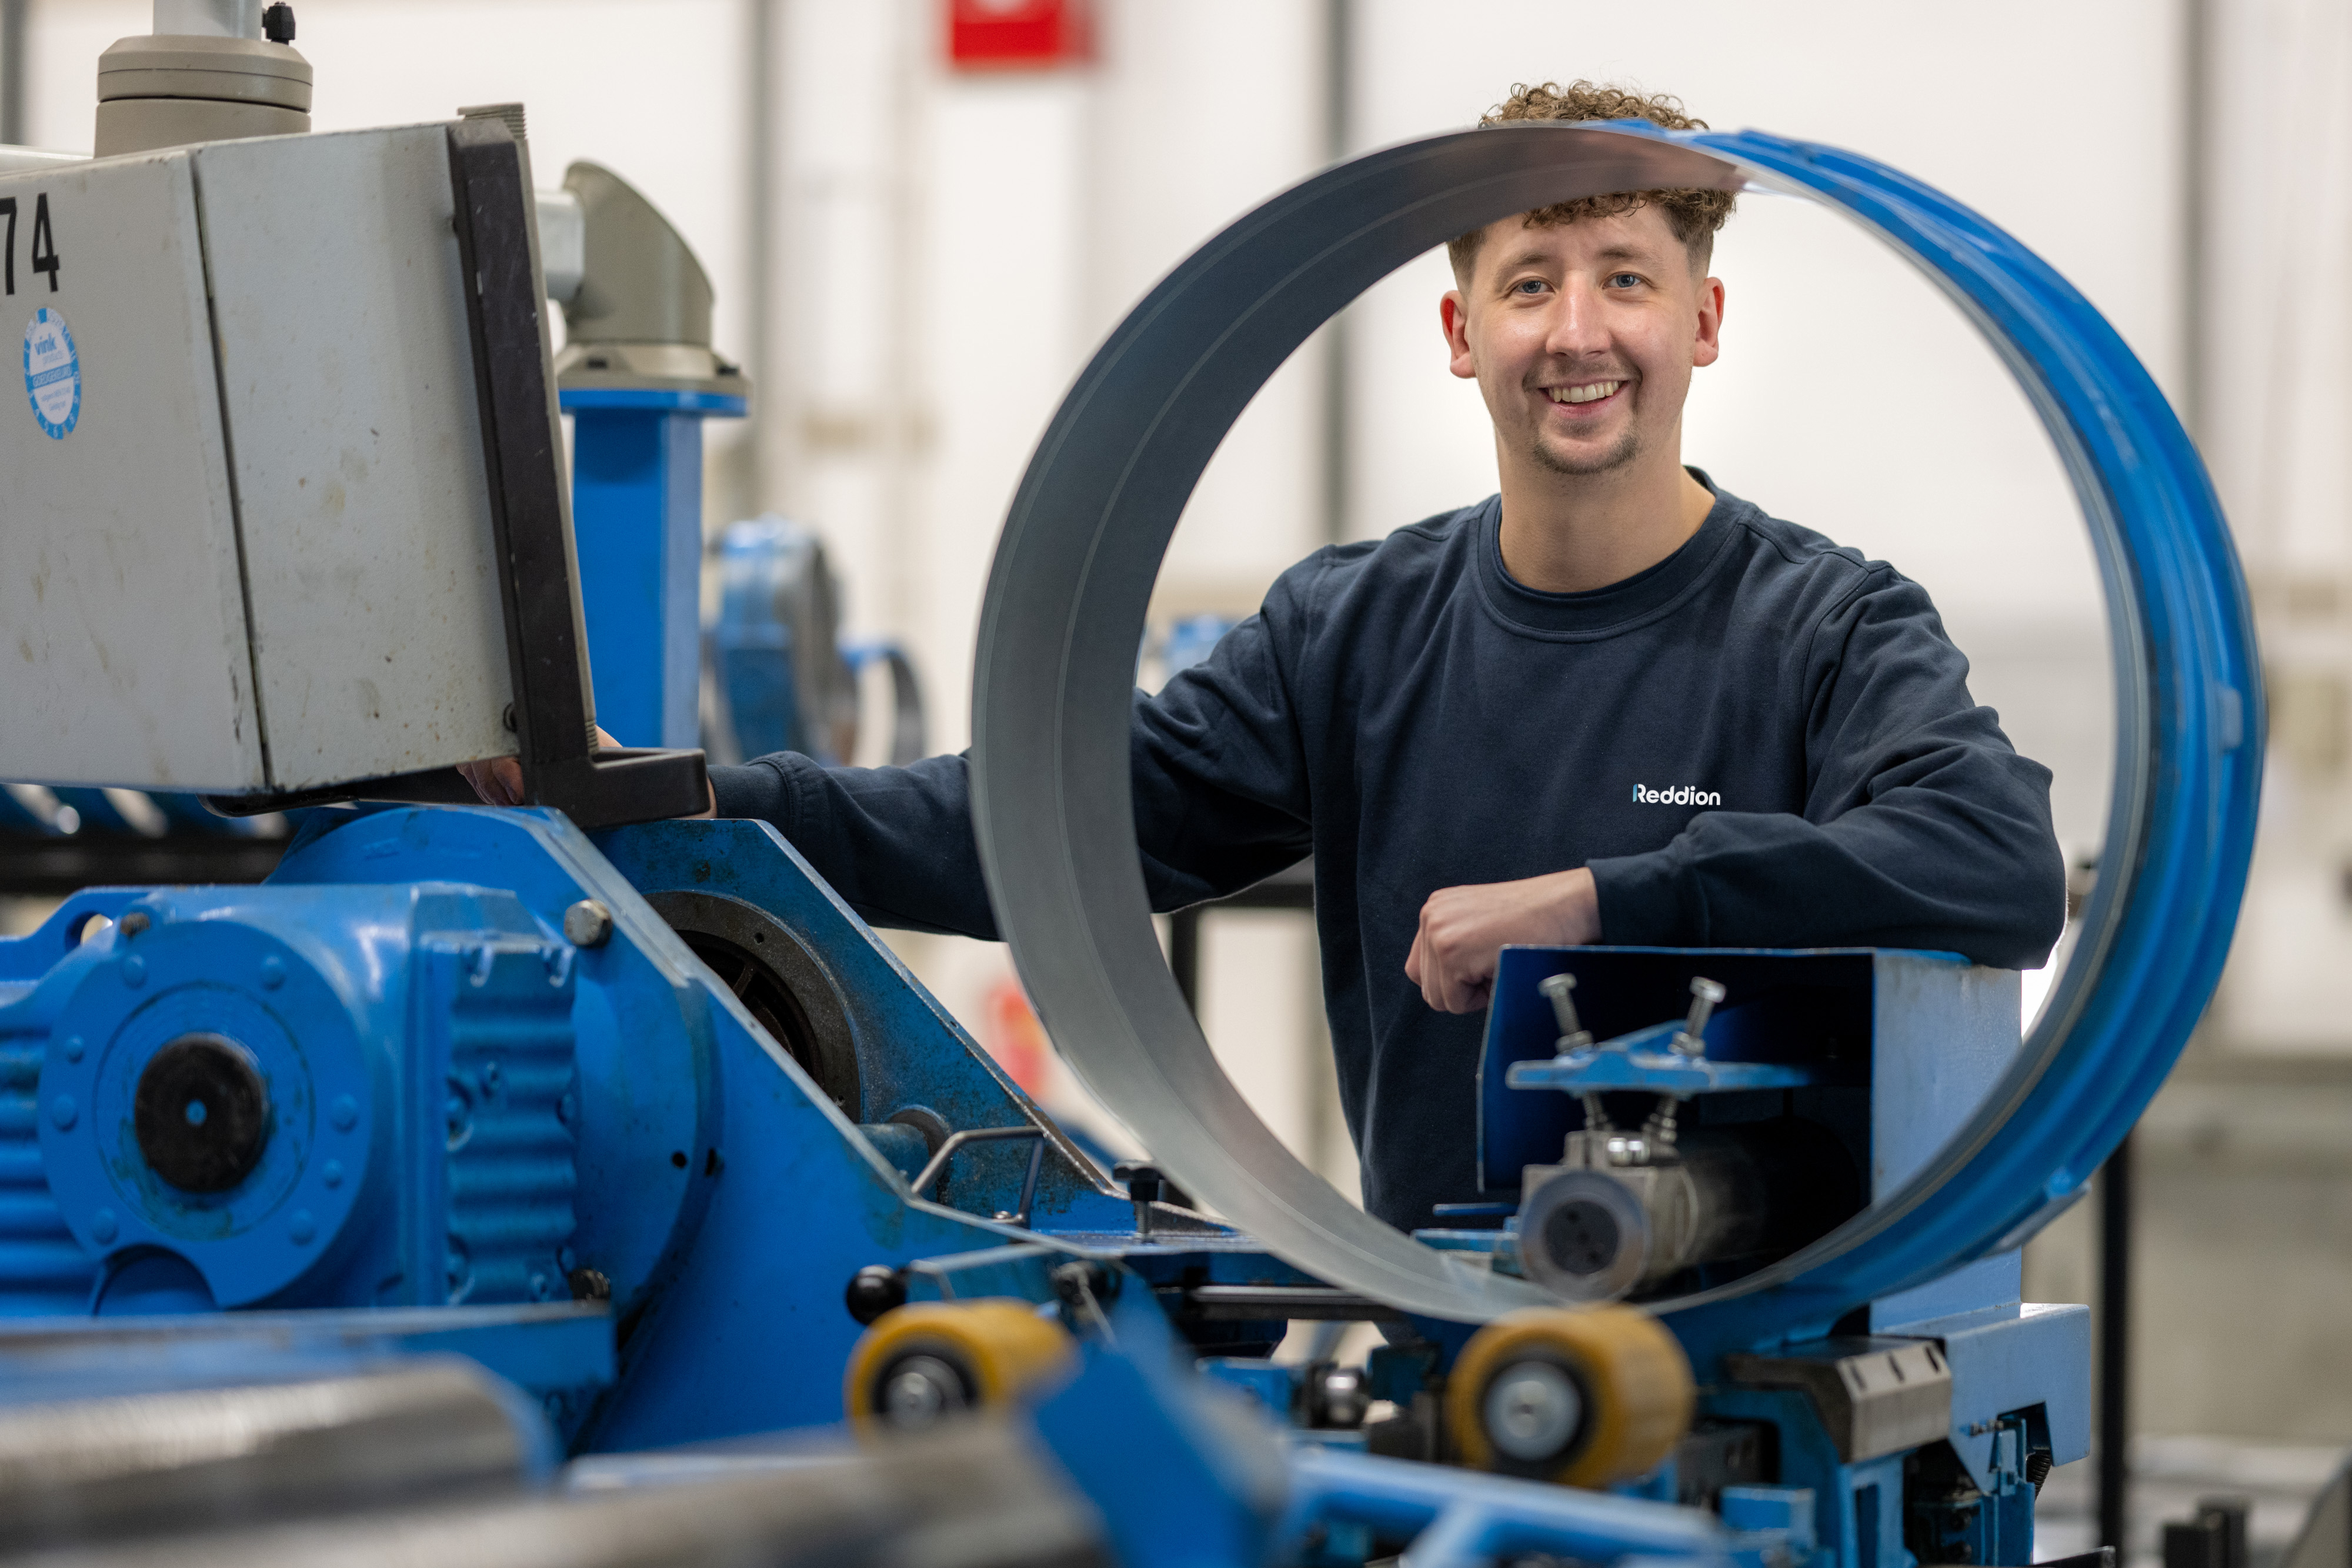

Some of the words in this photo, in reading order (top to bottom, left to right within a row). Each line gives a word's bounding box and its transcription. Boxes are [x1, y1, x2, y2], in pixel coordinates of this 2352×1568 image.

[0, 192, 59, 295] 74
[34, 333, 57, 355] vink
[1632, 783, 1721, 806] Reddion
